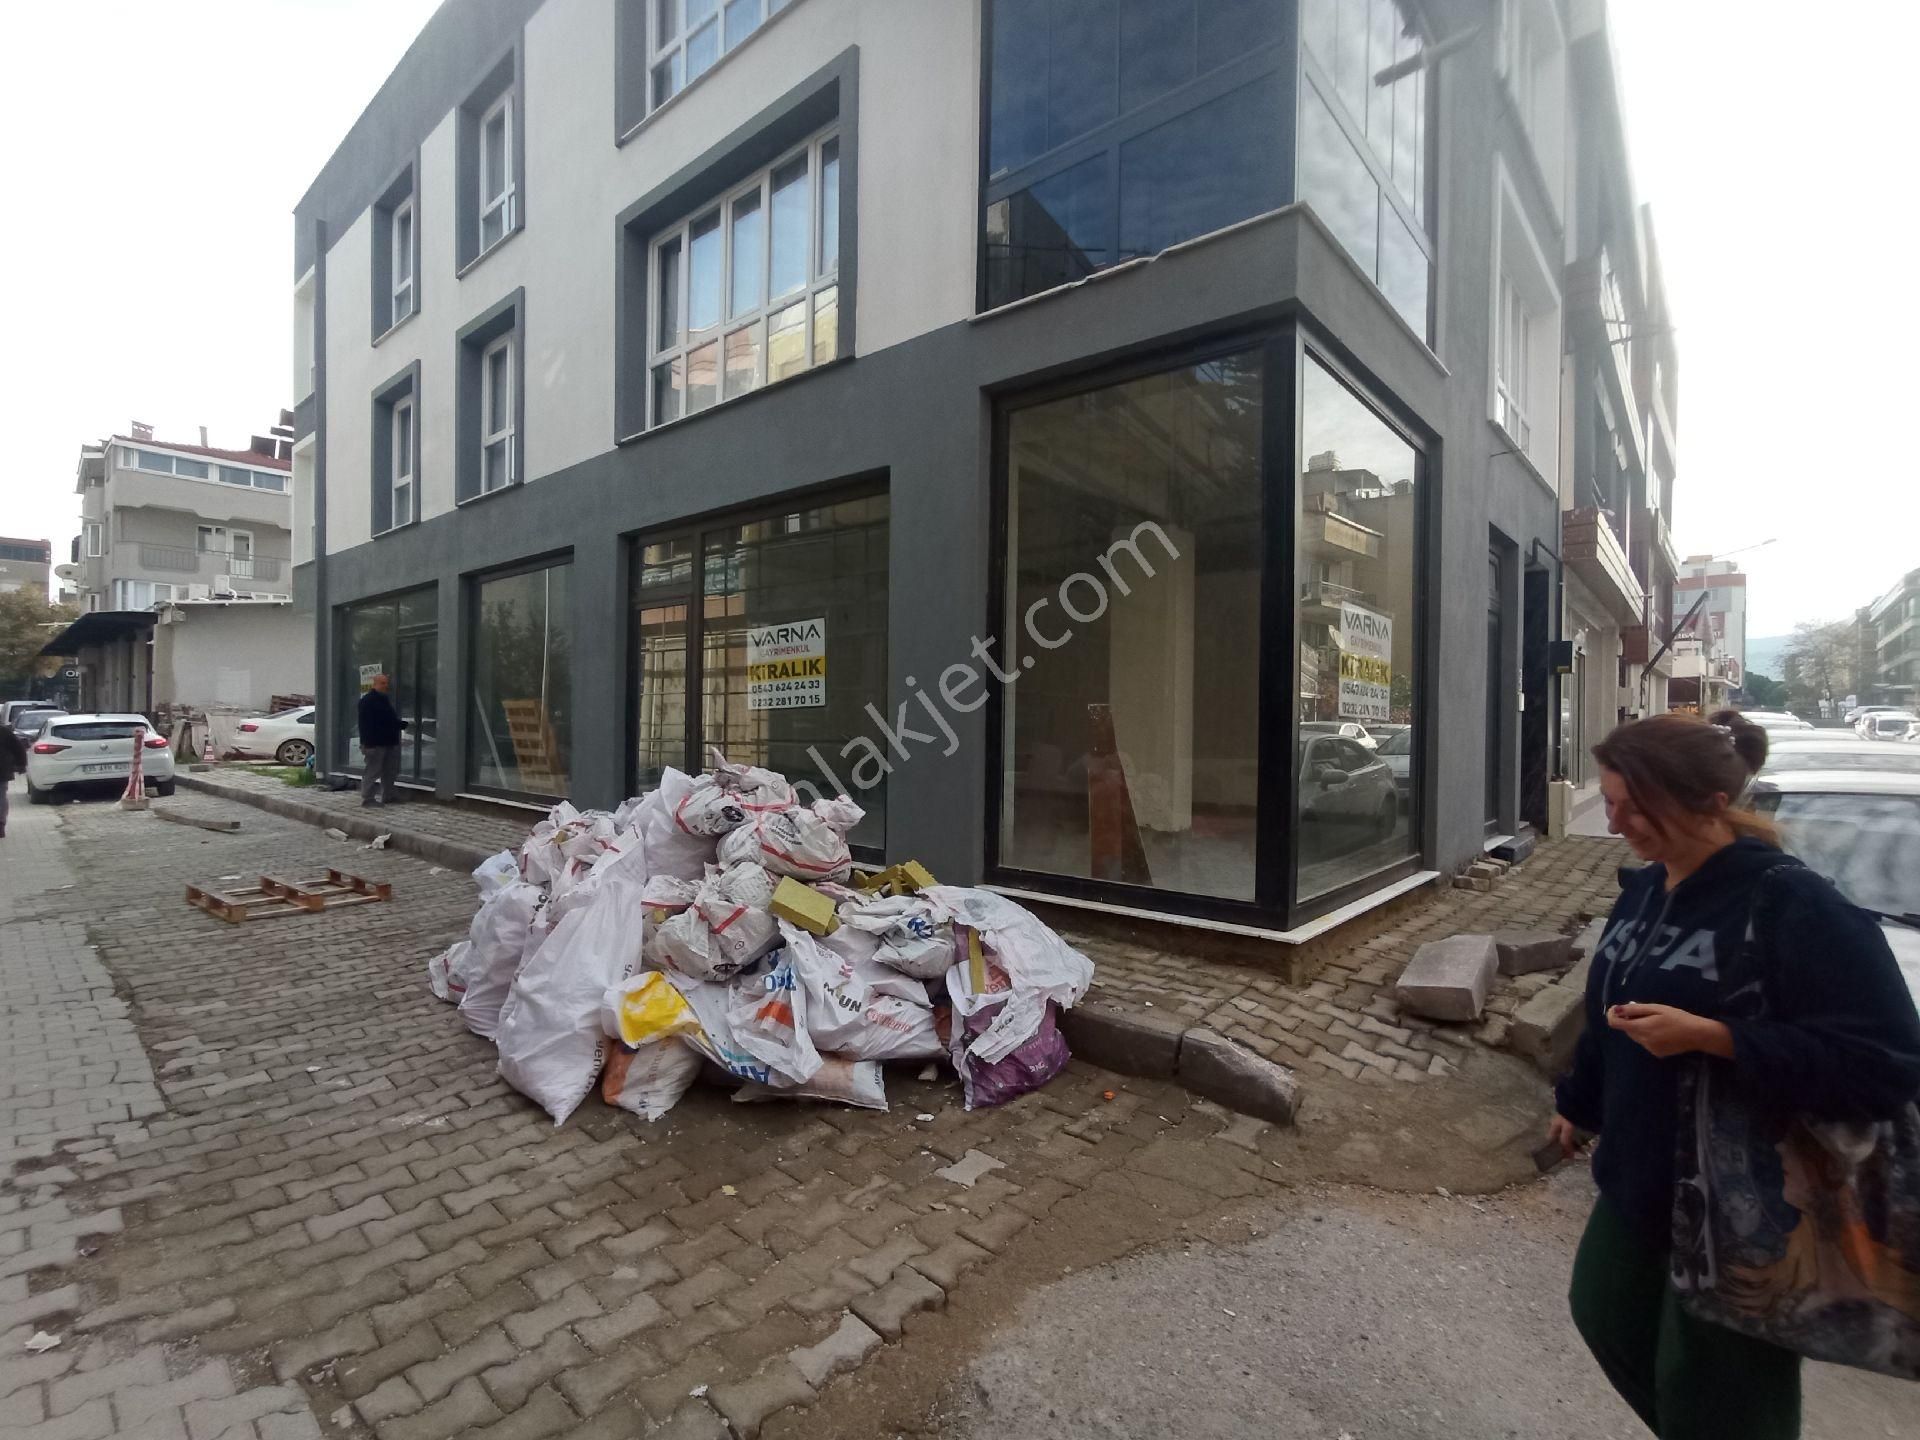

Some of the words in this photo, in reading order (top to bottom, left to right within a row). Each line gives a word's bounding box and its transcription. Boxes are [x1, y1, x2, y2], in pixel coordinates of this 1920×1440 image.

[1344, 609, 1389, 640] VARNA
[751, 624, 821, 647] VARNA
[776, 681, 792, 692] 624
[794, 681, 806, 690] 24
[808, 680, 820, 689] 33
[794, 695, 806, 705] 70
[808, 695, 820, 704] 15
